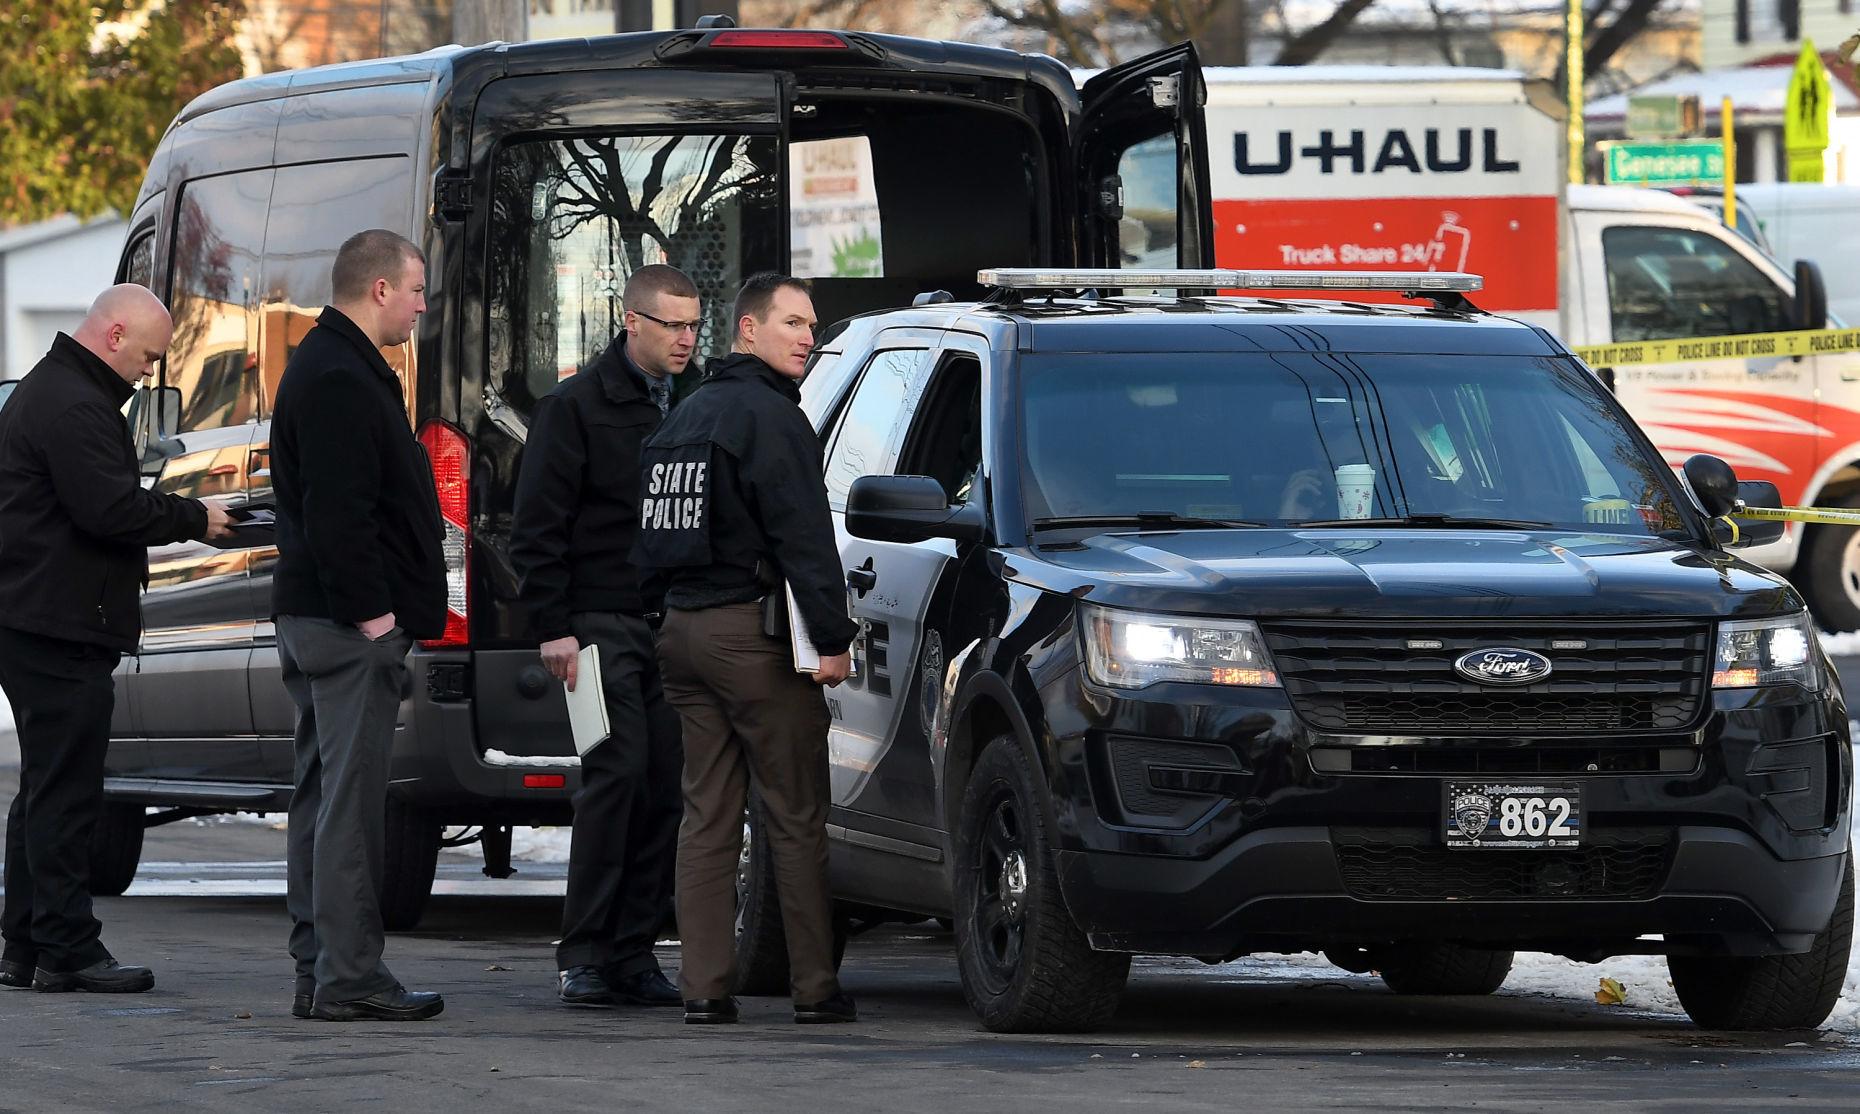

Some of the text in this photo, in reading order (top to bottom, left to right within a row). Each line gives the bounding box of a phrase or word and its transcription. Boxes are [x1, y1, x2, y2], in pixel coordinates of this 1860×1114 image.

[1234, 128, 1520, 175] U-HAUL
[1280, 240, 1446, 265] Truck Share 24/7
[1678, 338, 1775, 360] POLICE LINE DO NOT CROSS
[1809, 335, 1835, 351] POLICE
[1838, 333, 1854, 349] LINE
[1591, 349, 1601, 364] DO
[1604, 348, 1617, 363] NOT
[1620, 346, 1643, 362] CROSS
[649, 462, 706, 495] STATE
[641, 497, 703, 530] POLICE
[1479, 652, 1530, 673] Ford
[1457, 796, 1489, 809] POLICE
[1499, 797, 1571, 837] 862
